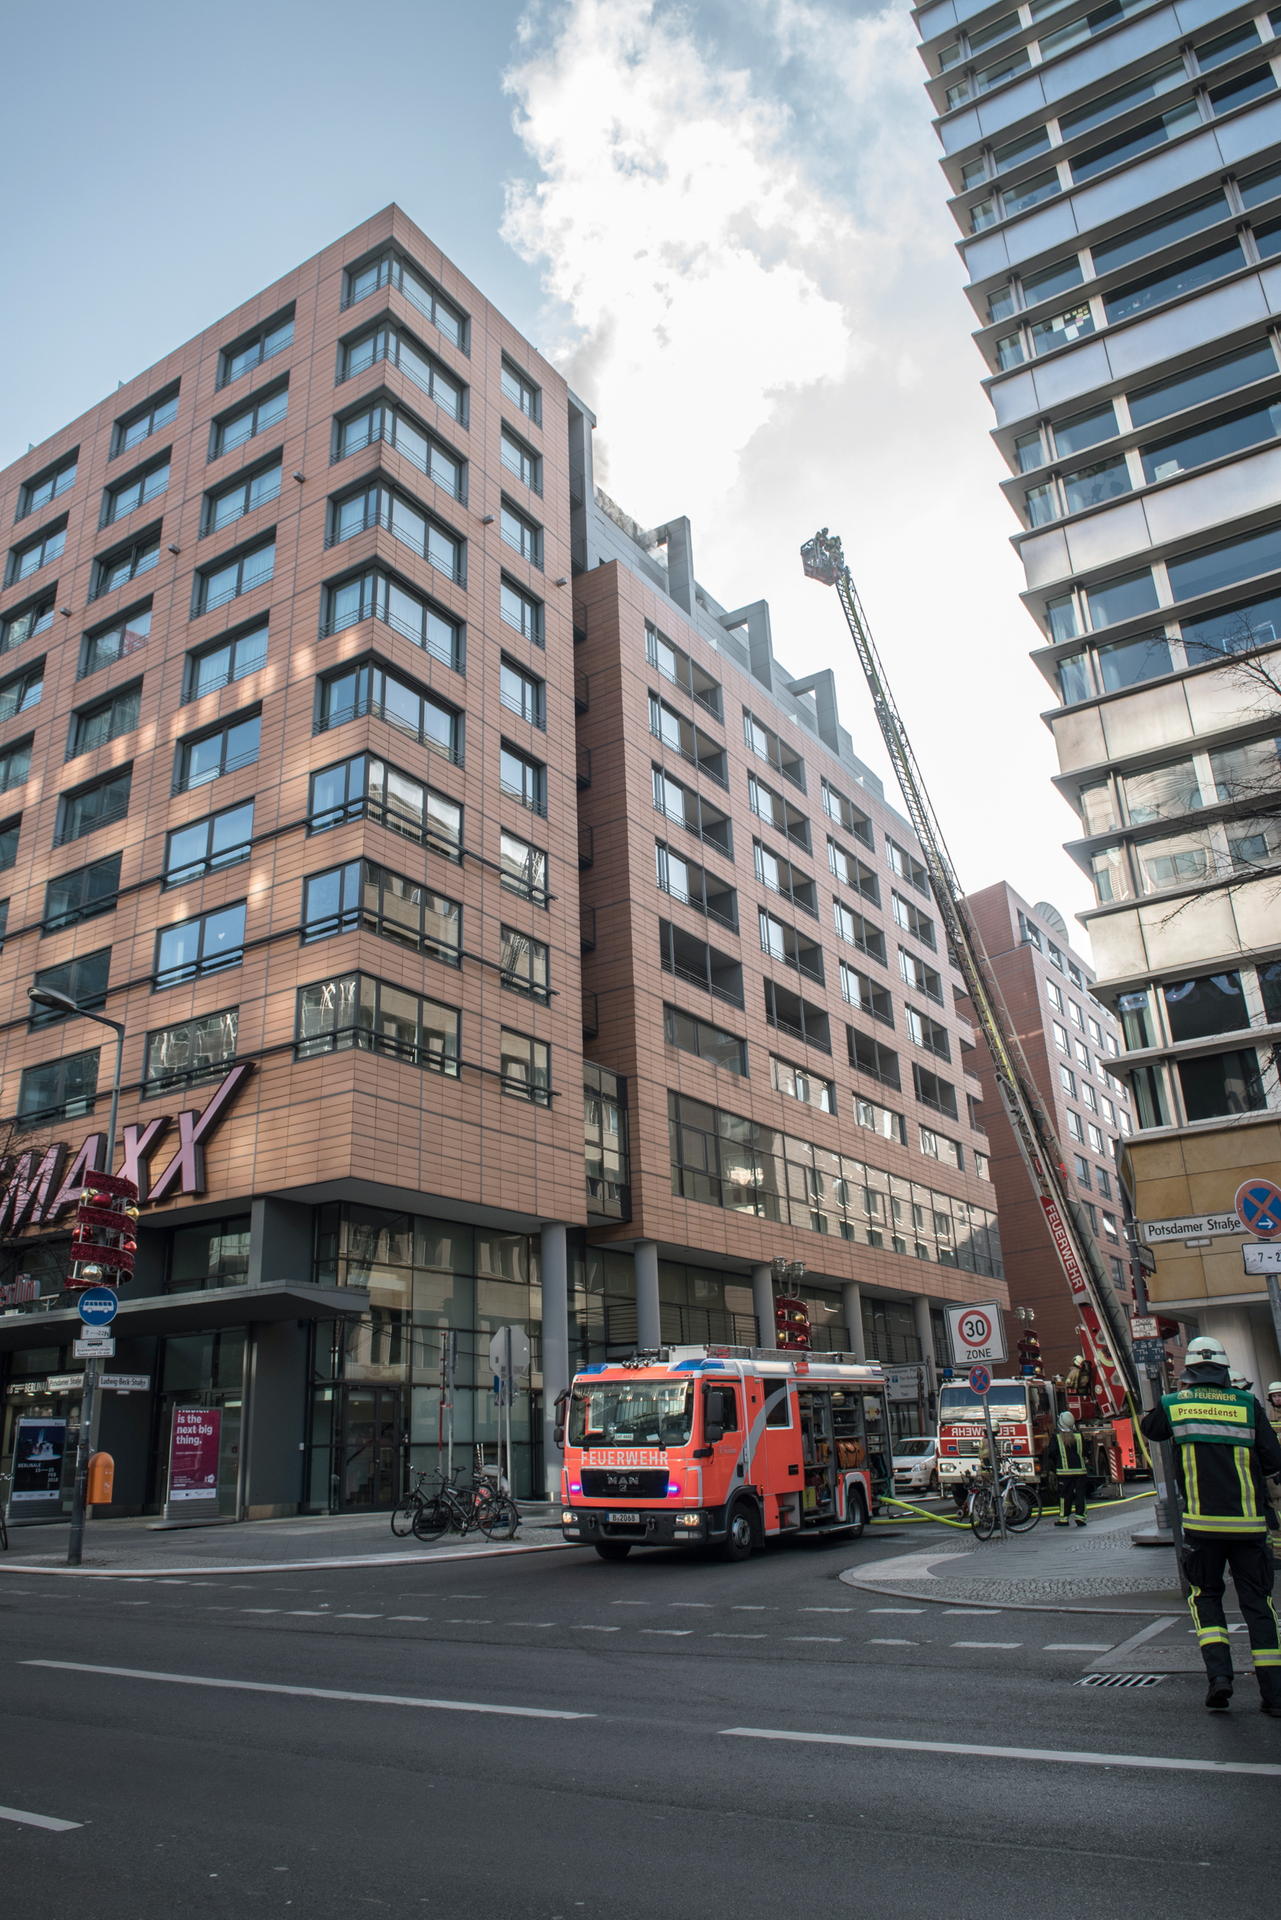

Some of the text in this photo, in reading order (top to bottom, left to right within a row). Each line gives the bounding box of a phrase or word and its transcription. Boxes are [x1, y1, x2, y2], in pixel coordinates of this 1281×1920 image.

[0, 1063, 252, 1230] MAXX
[1148, 1216, 1241, 1237] Potsdamer Straße
[1046, 1204, 1083, 1289] FEUERWEHR
[1257, 1252, 1264, 1263] 7
[965, 1319, 986, 1337] 30
[966, 1347, 993, 1360] ZONE
[1194, 1392, 1237, 1402] FEUERWEHR
[1178, 1407, 1238, 1418] Pressedienst
[177, 1414, 202, 1424] is the
[176, 1425, 213, 1435] next big
[176, 1436, 202, 1446] thing.
[581, 1451, 669, 1466] FEUERWEHR
[607, 1475, 640, 1486] MAN
